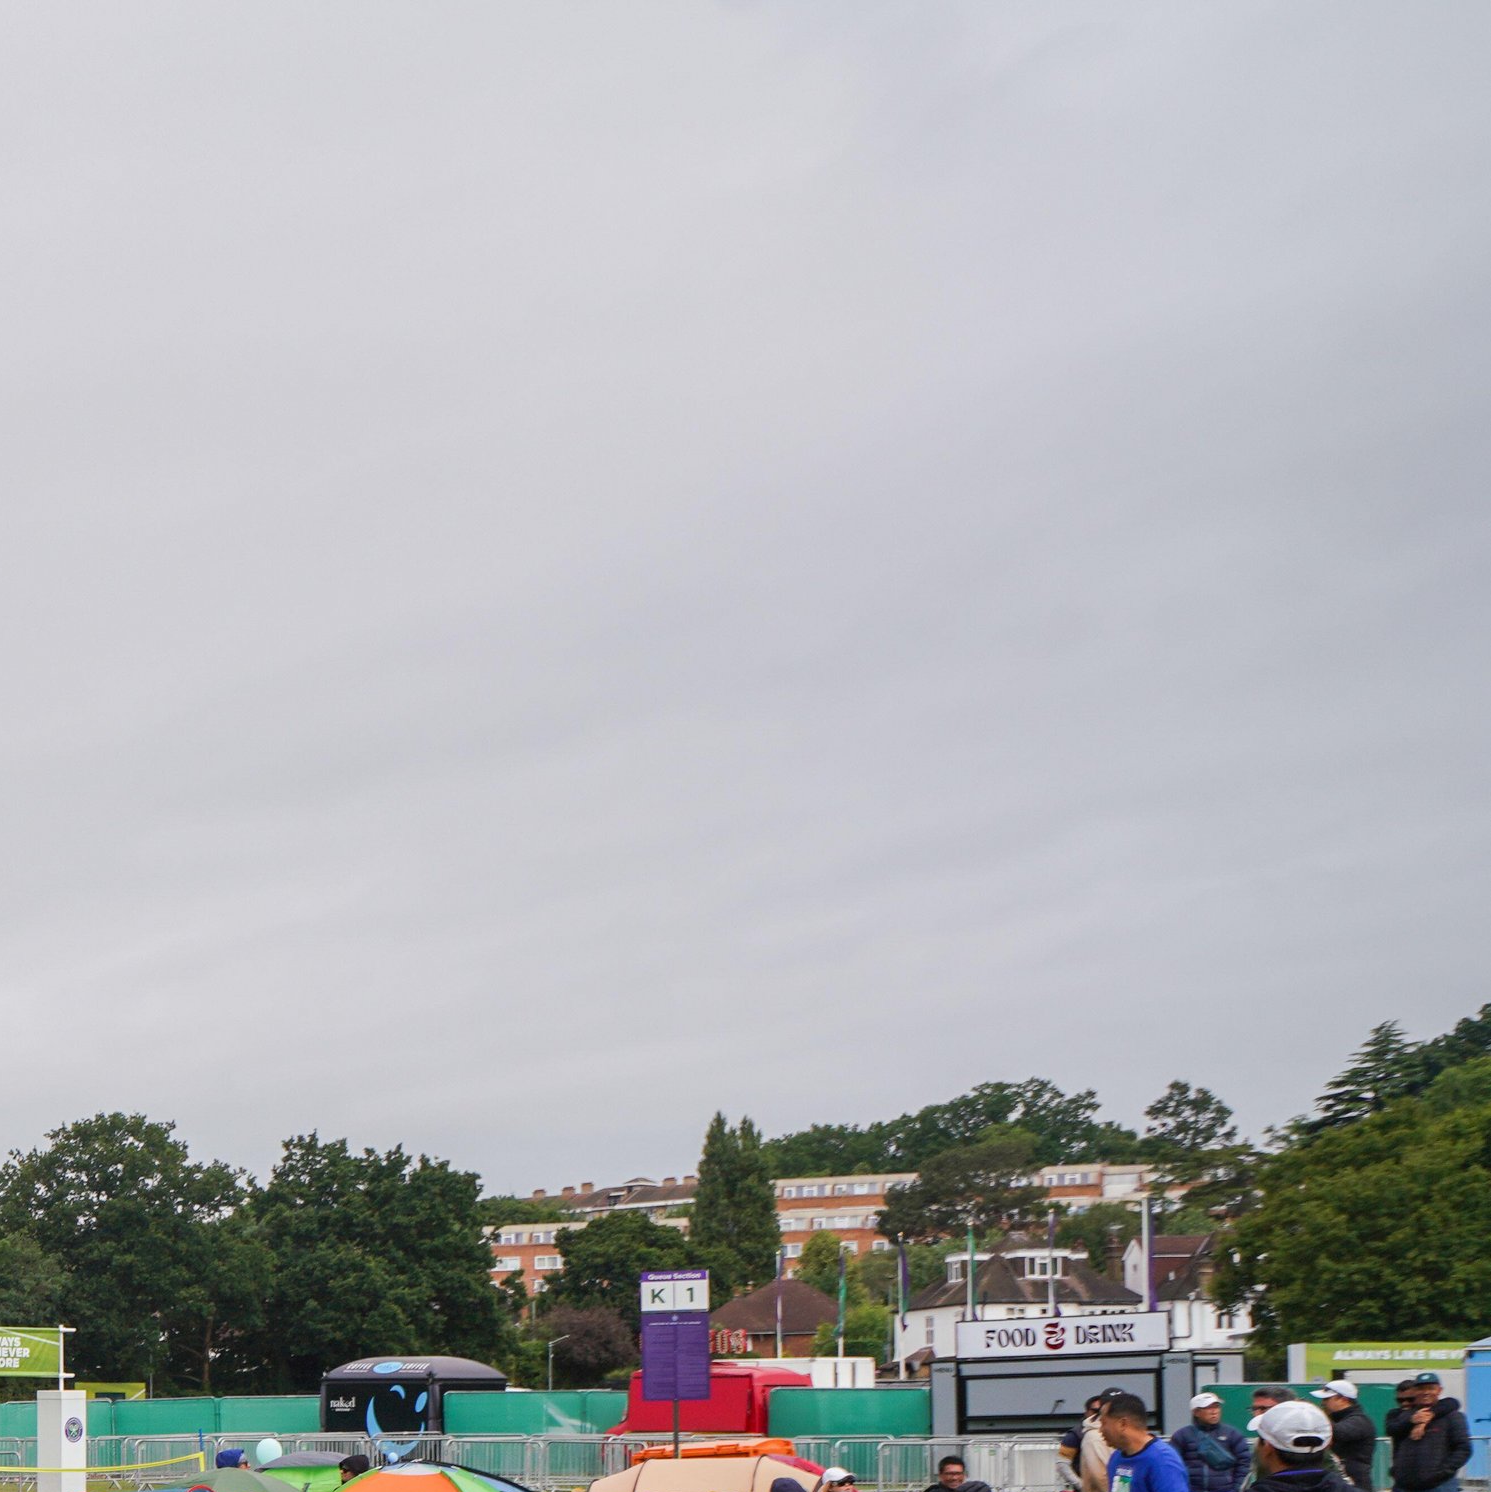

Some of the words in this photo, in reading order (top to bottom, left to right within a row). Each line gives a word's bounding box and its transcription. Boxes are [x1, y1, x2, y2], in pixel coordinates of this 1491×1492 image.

[651, 1288, 665, 1304] K
[686, 1287, 694, 1303] 1
[985, 1328, 1036, 1348] FOOD
[1074, 1323, 1135, 1344] DRINK
[1333, 1349, 1391, 1360] ALWAYS
[1393, 1349, 1426, 1360] LIKE
